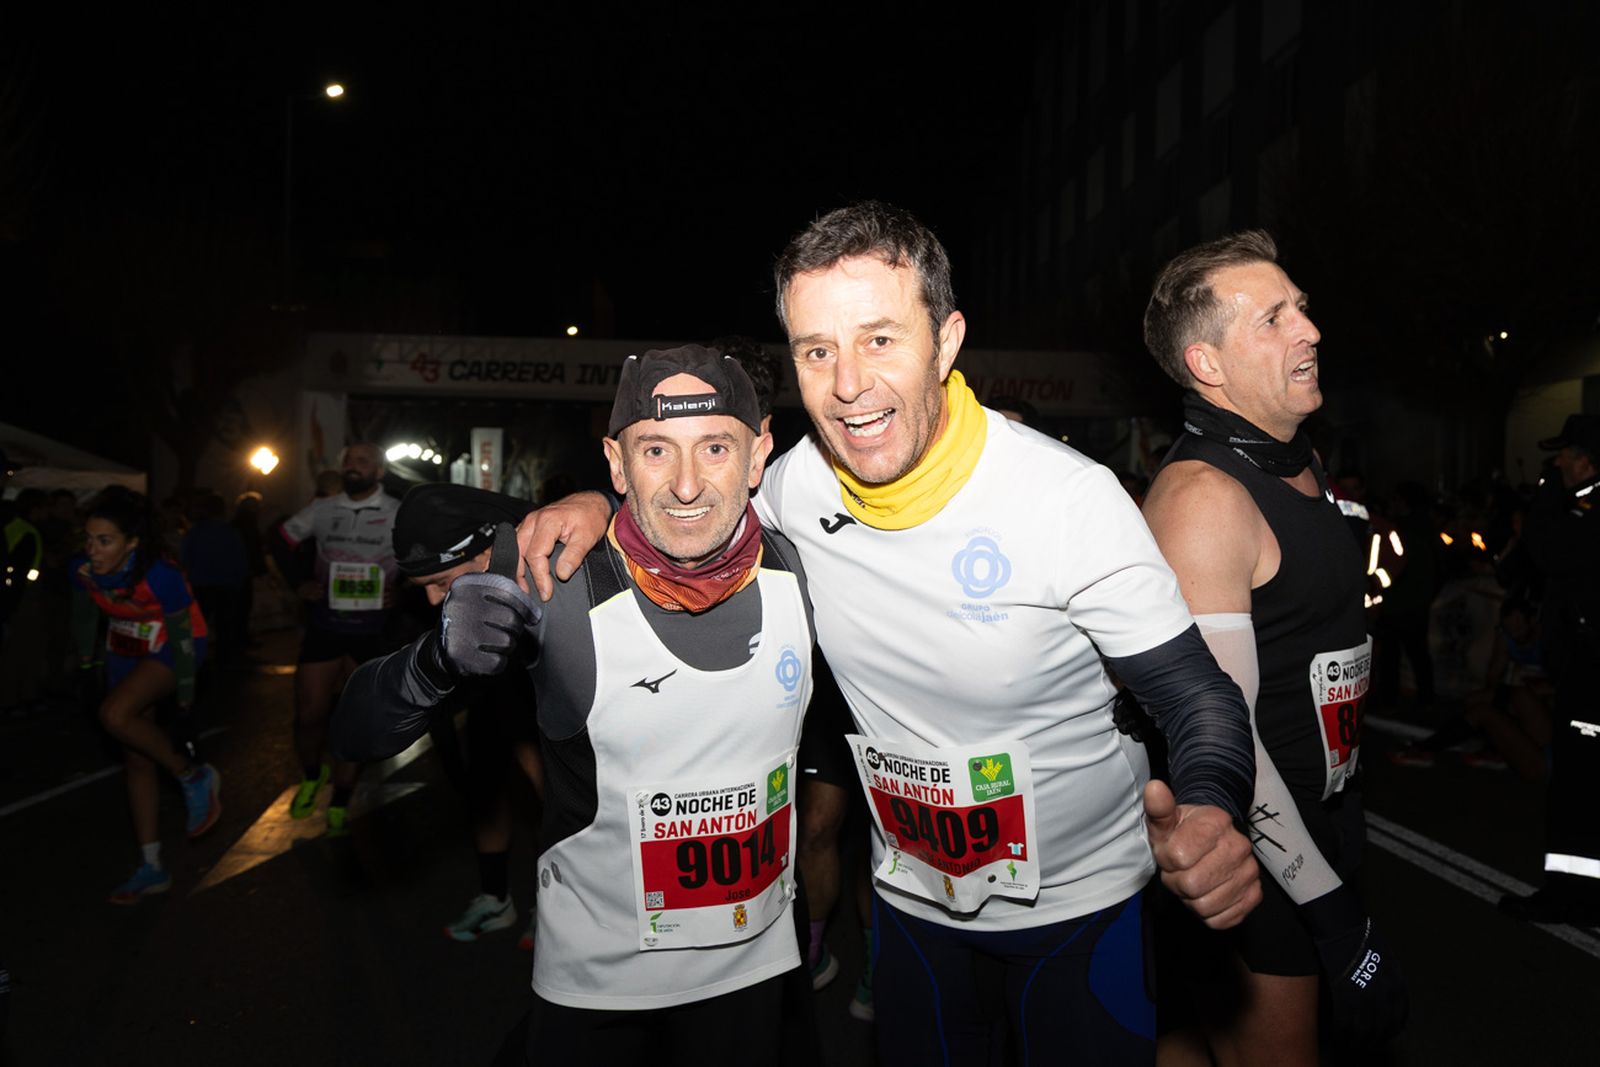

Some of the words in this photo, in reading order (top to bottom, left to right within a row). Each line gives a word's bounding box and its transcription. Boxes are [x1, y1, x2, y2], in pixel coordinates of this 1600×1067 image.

[410, 352, 442, 384] 43
[448, 359, 565, 384] CARRERA
[574, 362, 623, 385] INT
[989, 373, 1075, 401] ANTÓN
[661, 398, 716, 411] Kalenji
[961, 603, 991, 612] GRUPO
[1327, 665, 1340, 677] 43
[1327, 685, 1352, 702] SAN
[866, 752, 879, 765] 43
[884, 759, 927, 782] NOCHE
[931, 767, 951, 783] DE
[650, 798, 671, 812] 43
[674, 792, 698, 800] CARRERA
[698, 788, 719, 797] URBANA
[719, 782, 756, 795] INTERNACIONAL
[873, 774, 901, 795] SAN
[904, 784, 955, 806] ANTÓN
[975, 783, 991, 792] CAJA
[990, 779, 1012, 788] RURAL
[675, 793, 734, 816] NOCHE
[737, 788, 757, 808] DE
[654, 819, 693, 839] SAN
[696, 808, 758, 836] ANTÓN
[889, 797, 999, 860] 9409
[675, 817, 777, 890] 9014
[1355, 952, 1381, 989] GORE
